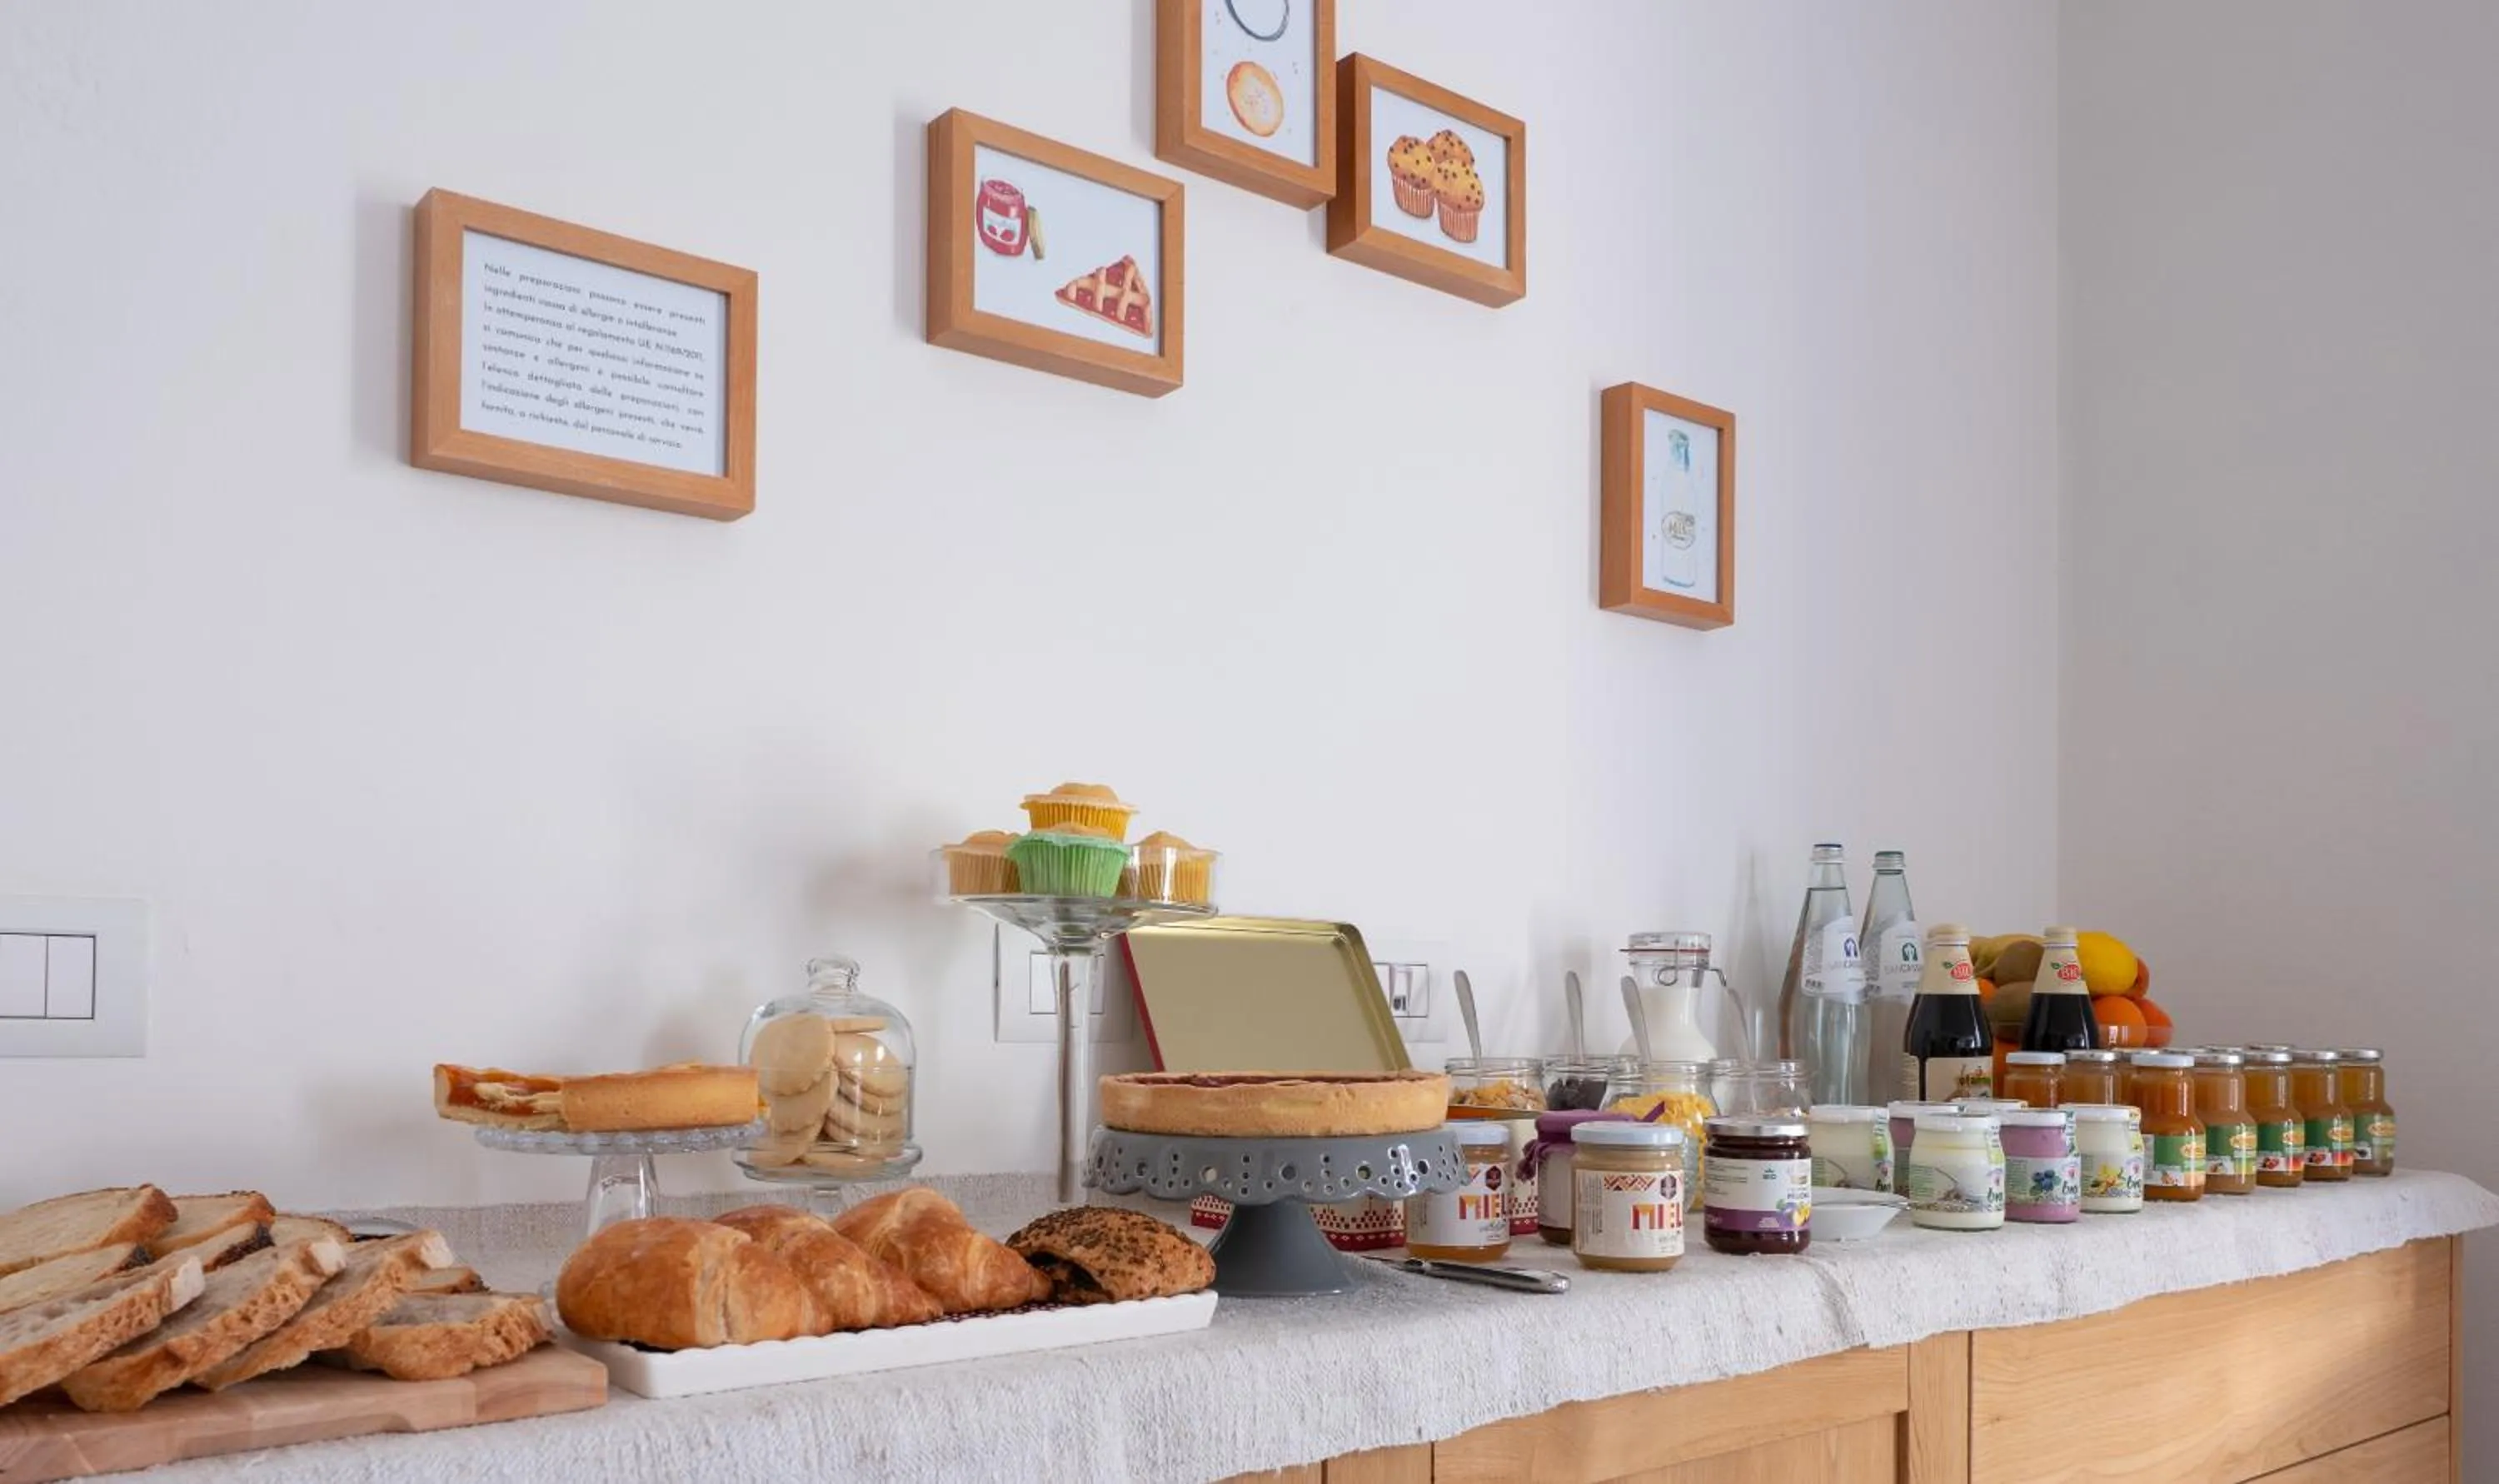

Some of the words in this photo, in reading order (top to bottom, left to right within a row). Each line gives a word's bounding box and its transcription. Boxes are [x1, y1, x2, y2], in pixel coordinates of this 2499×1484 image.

[484, 263, 511, 277] Nelle
[633, 302, 662, 314] essere
[669, 311, 705, 325] presenti
